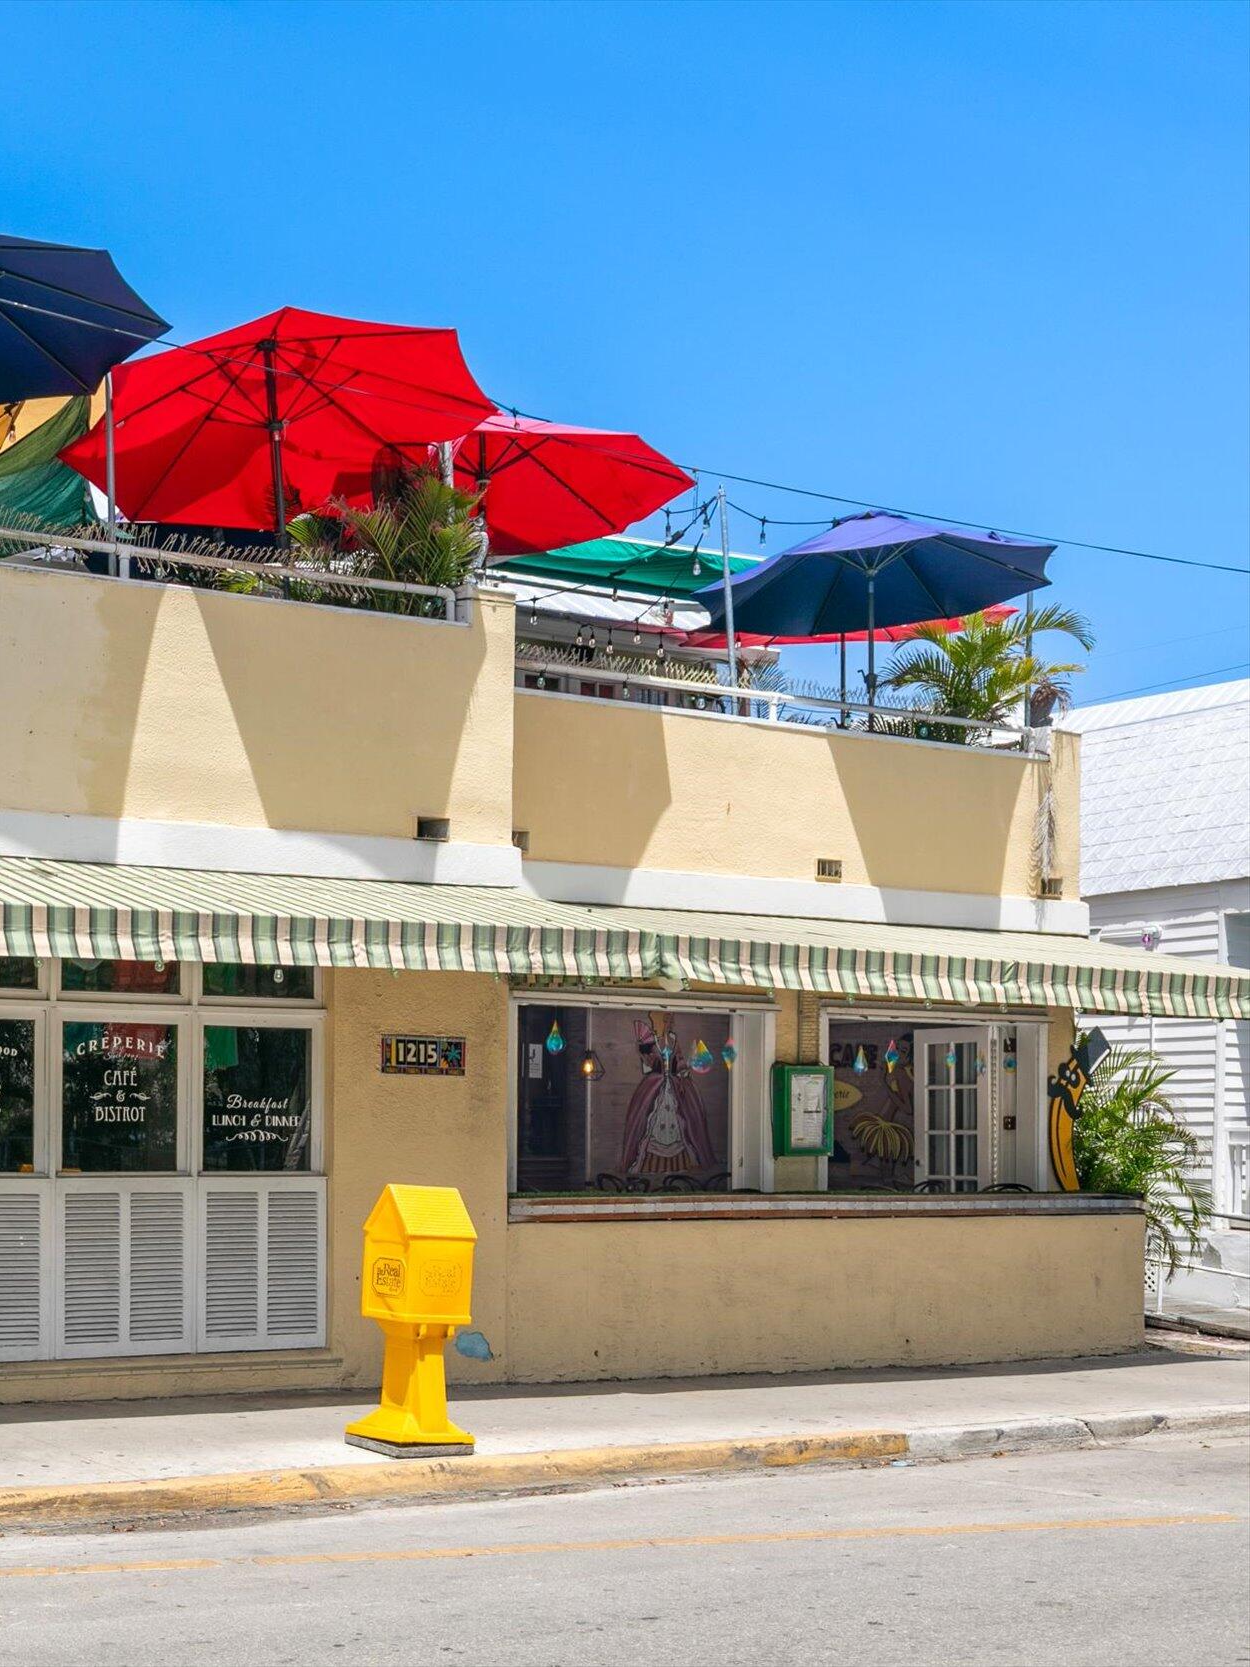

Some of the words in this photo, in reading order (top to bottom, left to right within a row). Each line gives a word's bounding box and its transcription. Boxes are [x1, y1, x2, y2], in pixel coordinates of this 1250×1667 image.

[76, 1030, 165, 1059] CRÊPERIE
[397, 1042, 437, 1063] 1215
[104, 1066, 137, 1086] CAFÉ
[116, 1090, 126, 1102] &
[227, 1094, 289, 1114] Breakfast
[94, 1106, 146, 1122] BISTROT
[212, 1114, 246, 1127] LUNCH
[250, 1113, 262, 1127] &
[265, 1115, 301, 1127] DINNER
